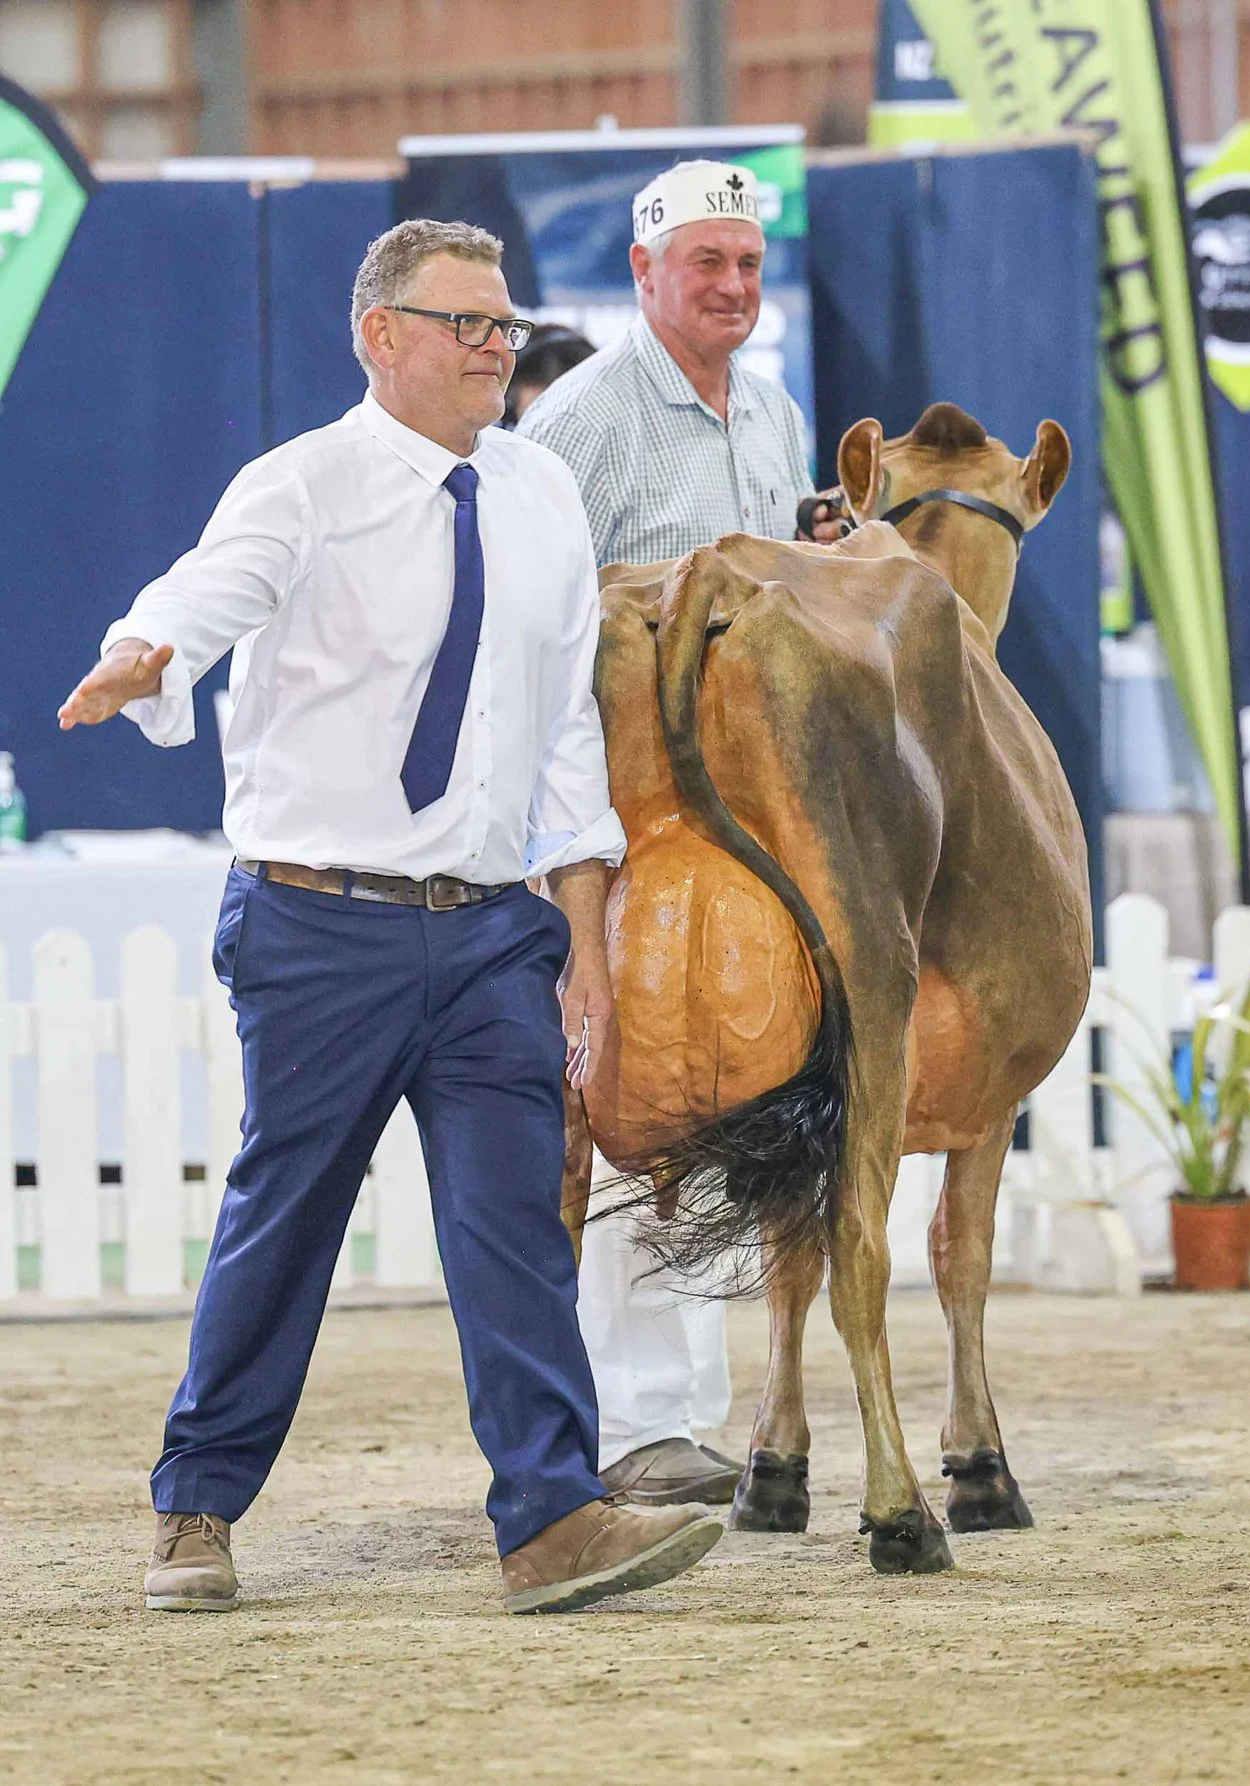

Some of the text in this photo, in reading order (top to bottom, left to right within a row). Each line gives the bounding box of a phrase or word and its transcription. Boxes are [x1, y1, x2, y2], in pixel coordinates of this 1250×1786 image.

[705, 191, 759, 217] SEME
[1031, 0, 1167, 394] AWEED
[634, 198, 664, 237] 76
